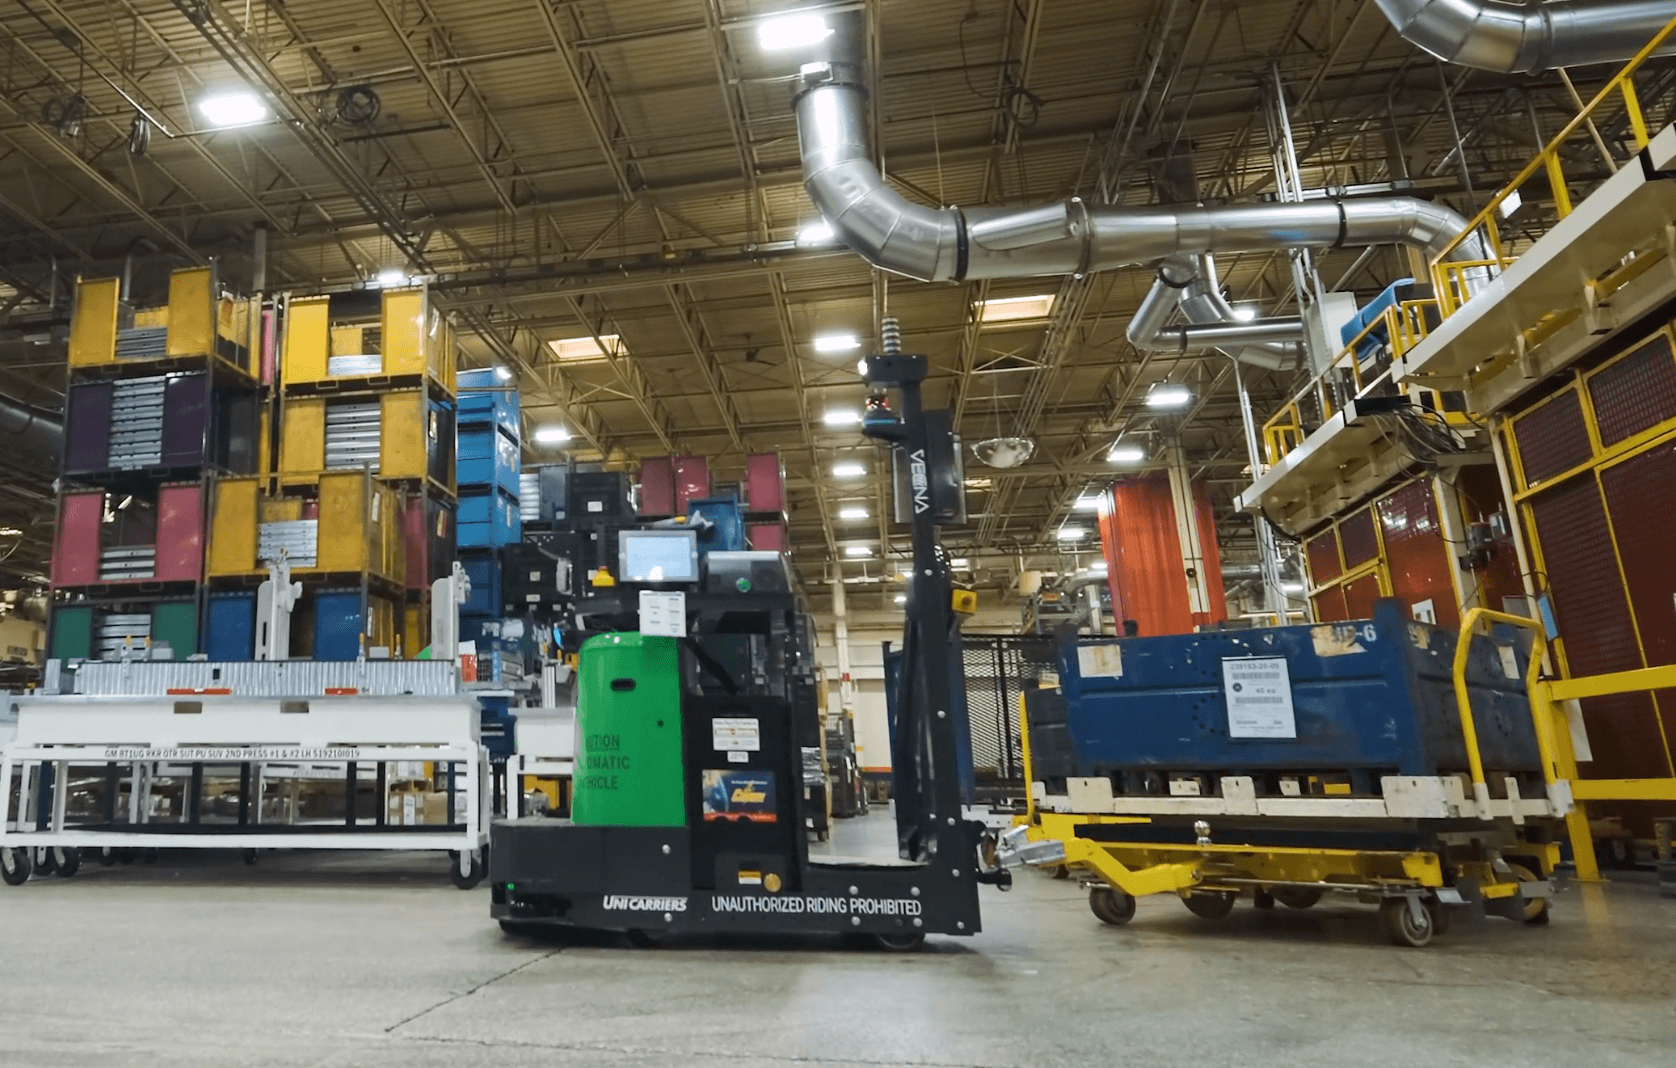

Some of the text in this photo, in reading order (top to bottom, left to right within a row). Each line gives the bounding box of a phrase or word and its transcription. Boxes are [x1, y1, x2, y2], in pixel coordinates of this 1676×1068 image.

[208, 749, 223, 758] SUV
[226, 749, 241, 758] 2ND
[243, 749, 268, 758] PRESS
[711, 896, 922, 916] UNAUTHORIZED RIDING PROHIBITED
